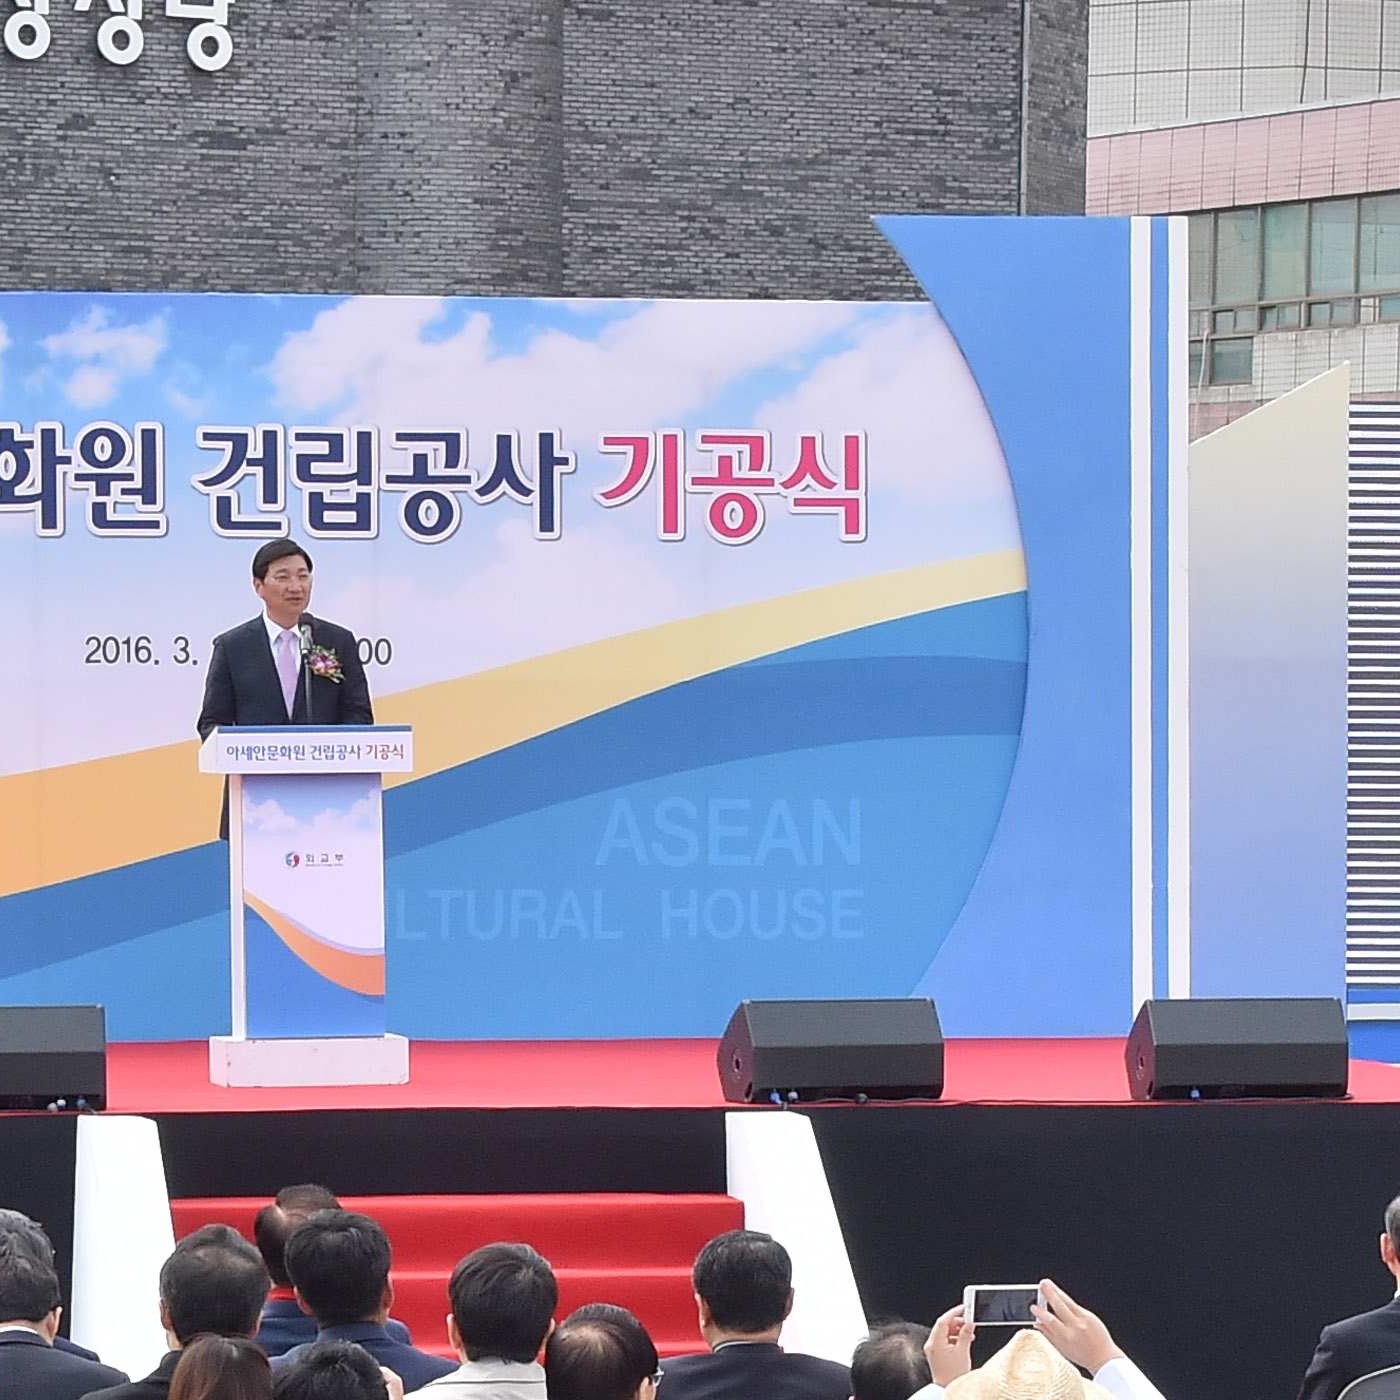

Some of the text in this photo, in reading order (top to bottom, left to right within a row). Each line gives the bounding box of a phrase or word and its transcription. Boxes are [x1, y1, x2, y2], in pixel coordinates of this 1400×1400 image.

[195, 425, 575, 540] 건립공사
[597, 428, 870, 541] 기공식
[85, 636, 160, 666] 2016.
[173, 636, 198, 666] 3.
[226, 744, 404, 761] 아세안문화원 건립공사 기공식
[595, 797, 861, 867] ASEAN
[386, 887, 864, 941] LTURAL HOUSE
